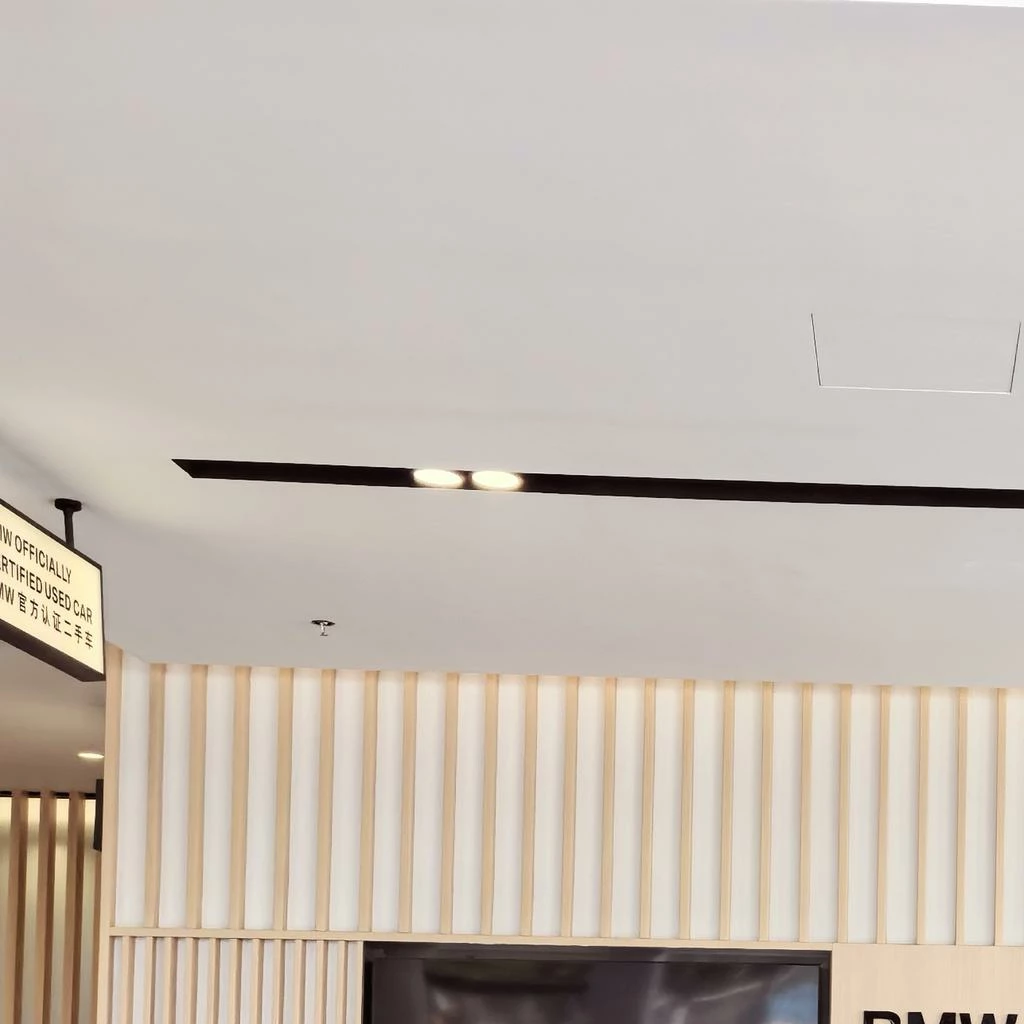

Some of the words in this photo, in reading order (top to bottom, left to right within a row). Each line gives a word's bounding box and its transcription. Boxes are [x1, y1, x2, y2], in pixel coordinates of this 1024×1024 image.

[0, 524, 12, 547] W
[15, 535, 71, 584] OFFICIALLY
[0, 554, 42, 594] RTIFIED
[45, 582, 71, 611] USED
[74, 600, 93, 624] CAR
[18, 591, 93, 649] 官方认证二手车
